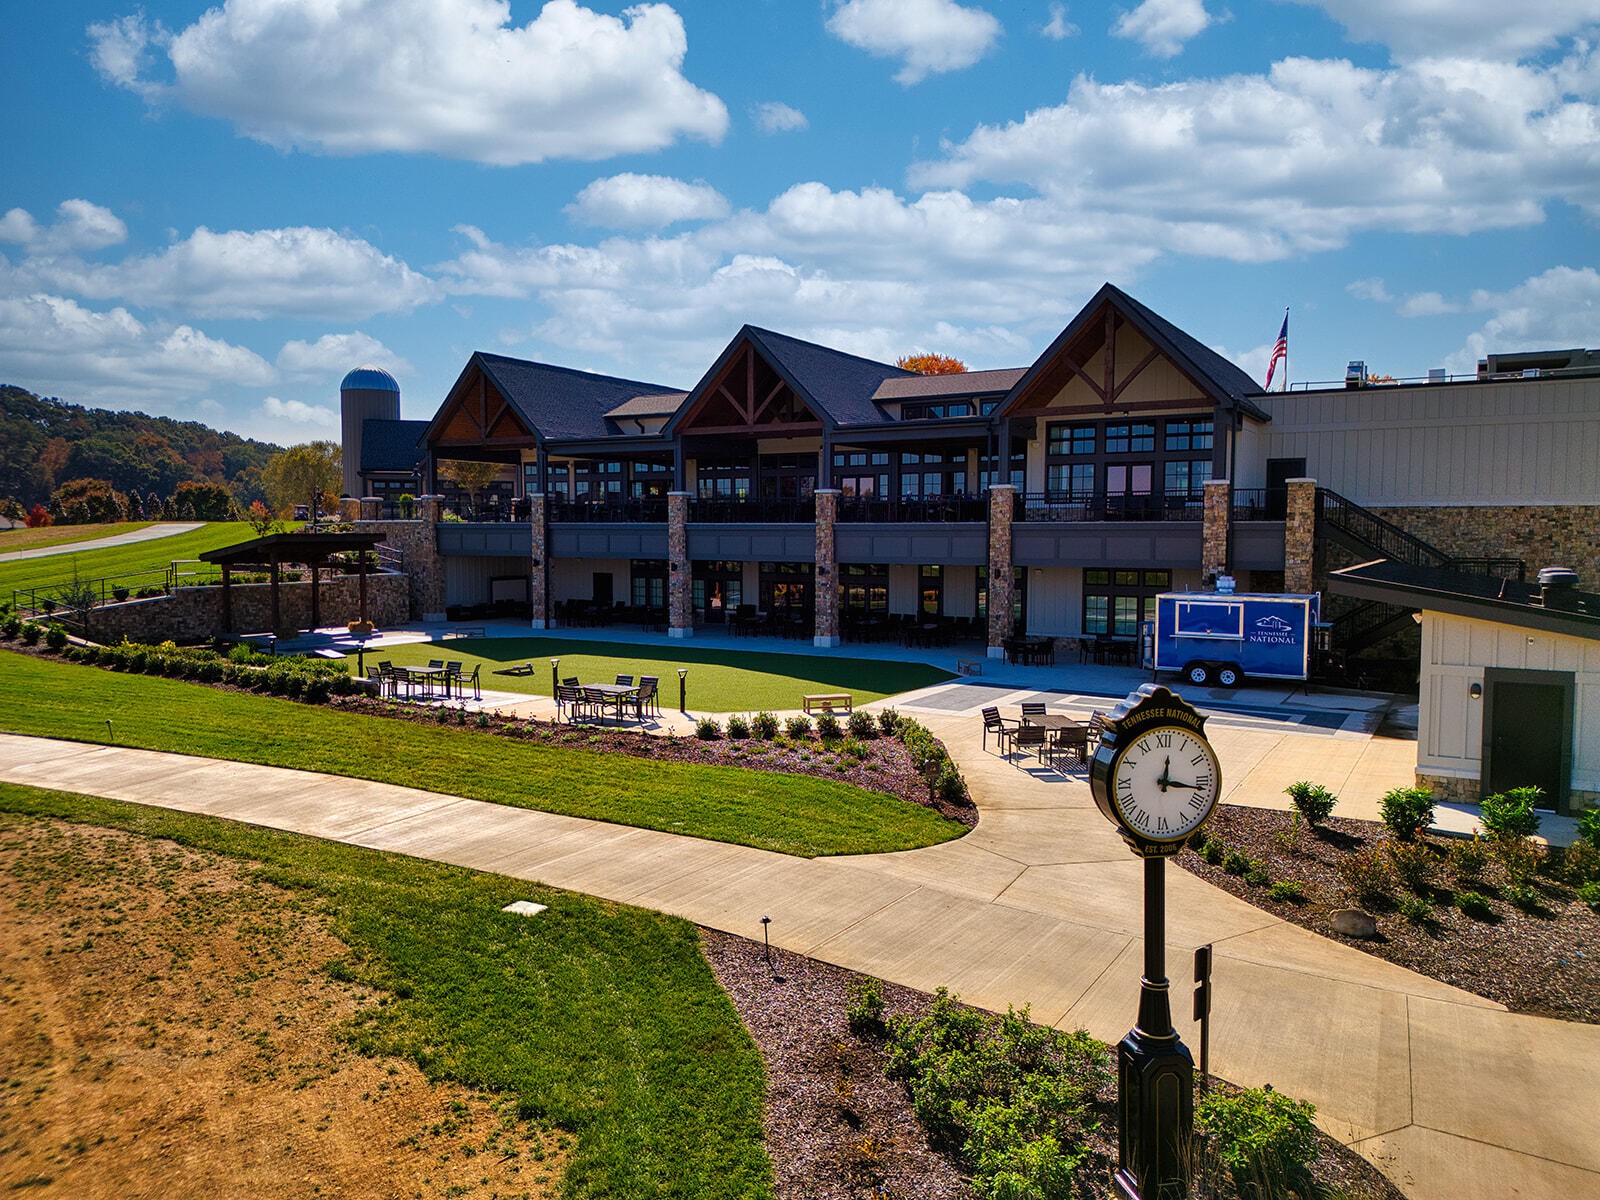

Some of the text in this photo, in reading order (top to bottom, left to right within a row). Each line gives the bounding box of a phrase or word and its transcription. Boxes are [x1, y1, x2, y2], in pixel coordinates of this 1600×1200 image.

[1250, 635, 1296, 644] NATIONAL
[1122, 708, 1201, 729] TENNESSEE NATIONAL
